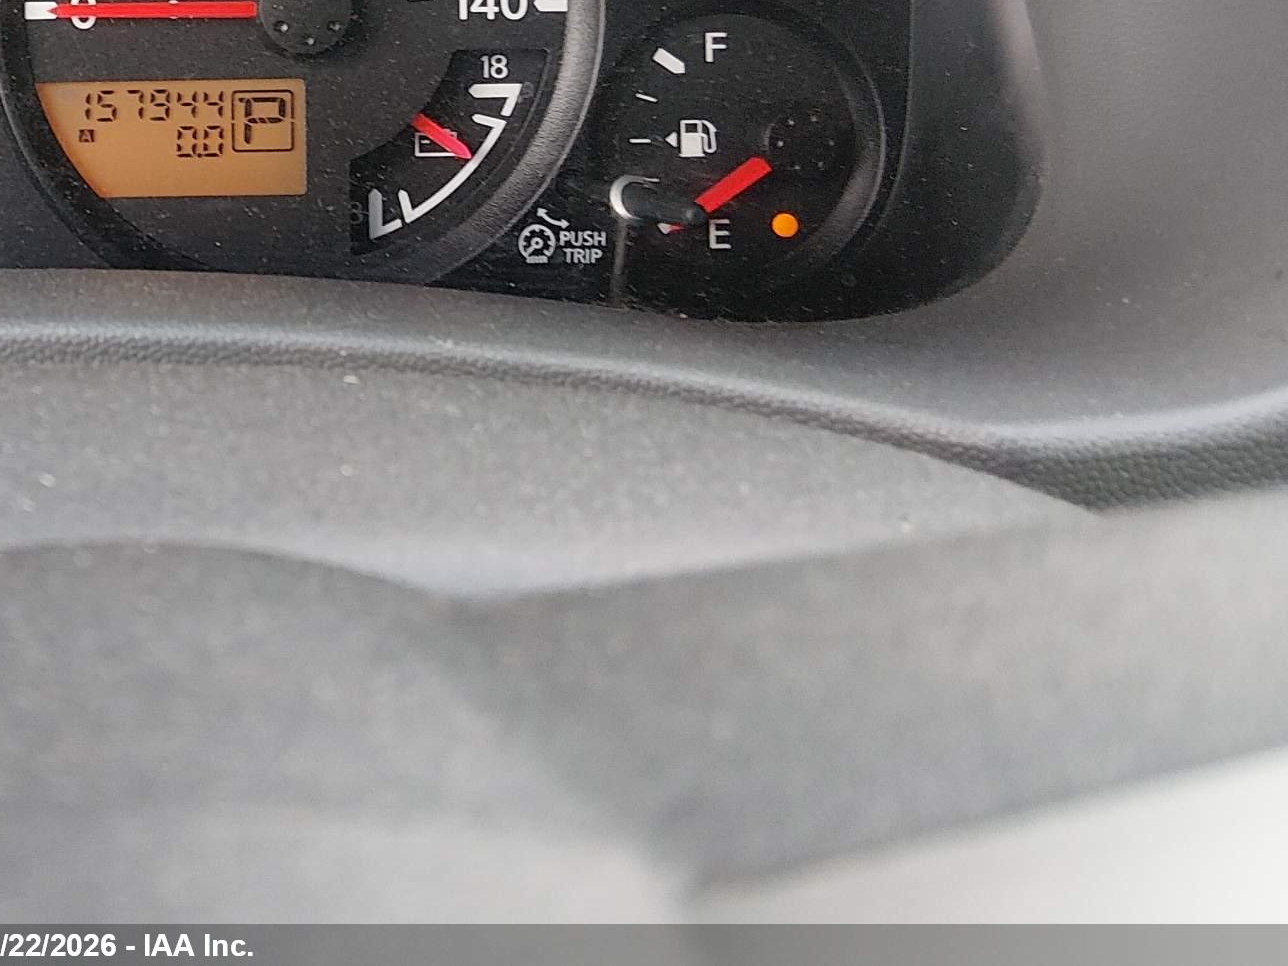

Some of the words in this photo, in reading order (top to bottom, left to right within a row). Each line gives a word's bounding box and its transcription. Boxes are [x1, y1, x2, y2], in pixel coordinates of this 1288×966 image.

[705, 32, 727, 63] F
[481, 54, 509, 79] 18
[84, 88, 225, 123] 157944
[238, 96, 287, 145] P
[176, 124, 224, 159] 0.0
[559, 230, 607, 247] PUSH
[708, 218, 732, 250] E
[562, 247, 603, 264] TRIP
